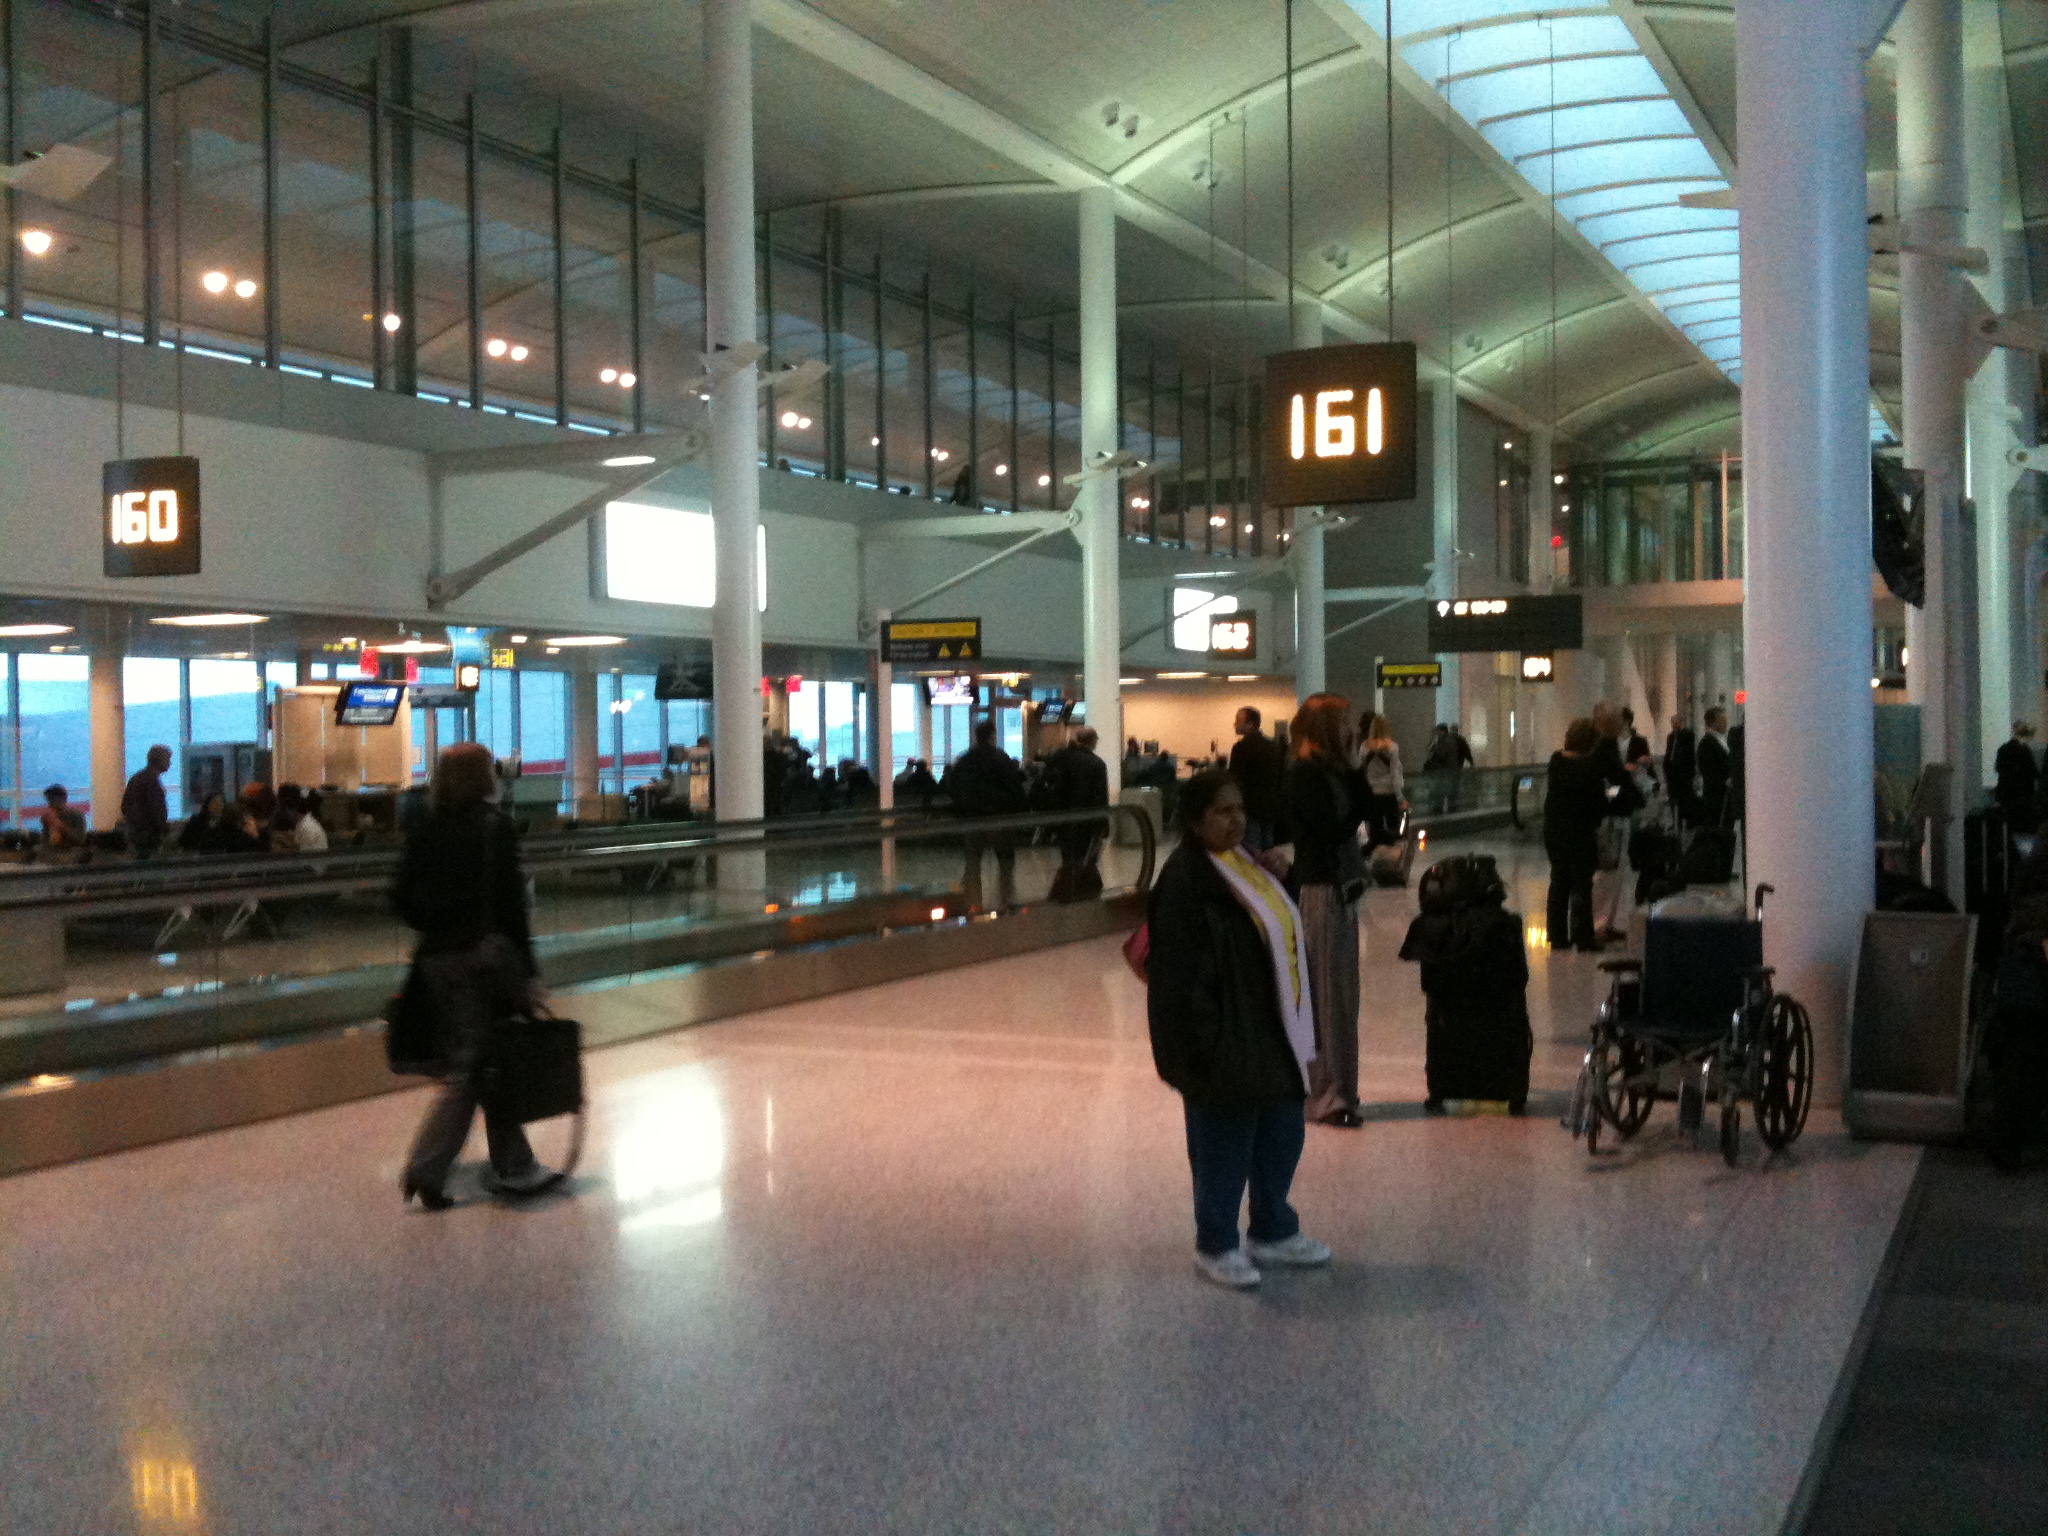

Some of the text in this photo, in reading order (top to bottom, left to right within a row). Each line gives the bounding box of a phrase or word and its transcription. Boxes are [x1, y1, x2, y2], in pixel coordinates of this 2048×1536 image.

[1289, 387, 1384, 460] 161
[110, 489, 180, 544] 160
[1212, 622, 1250, 651] 162
